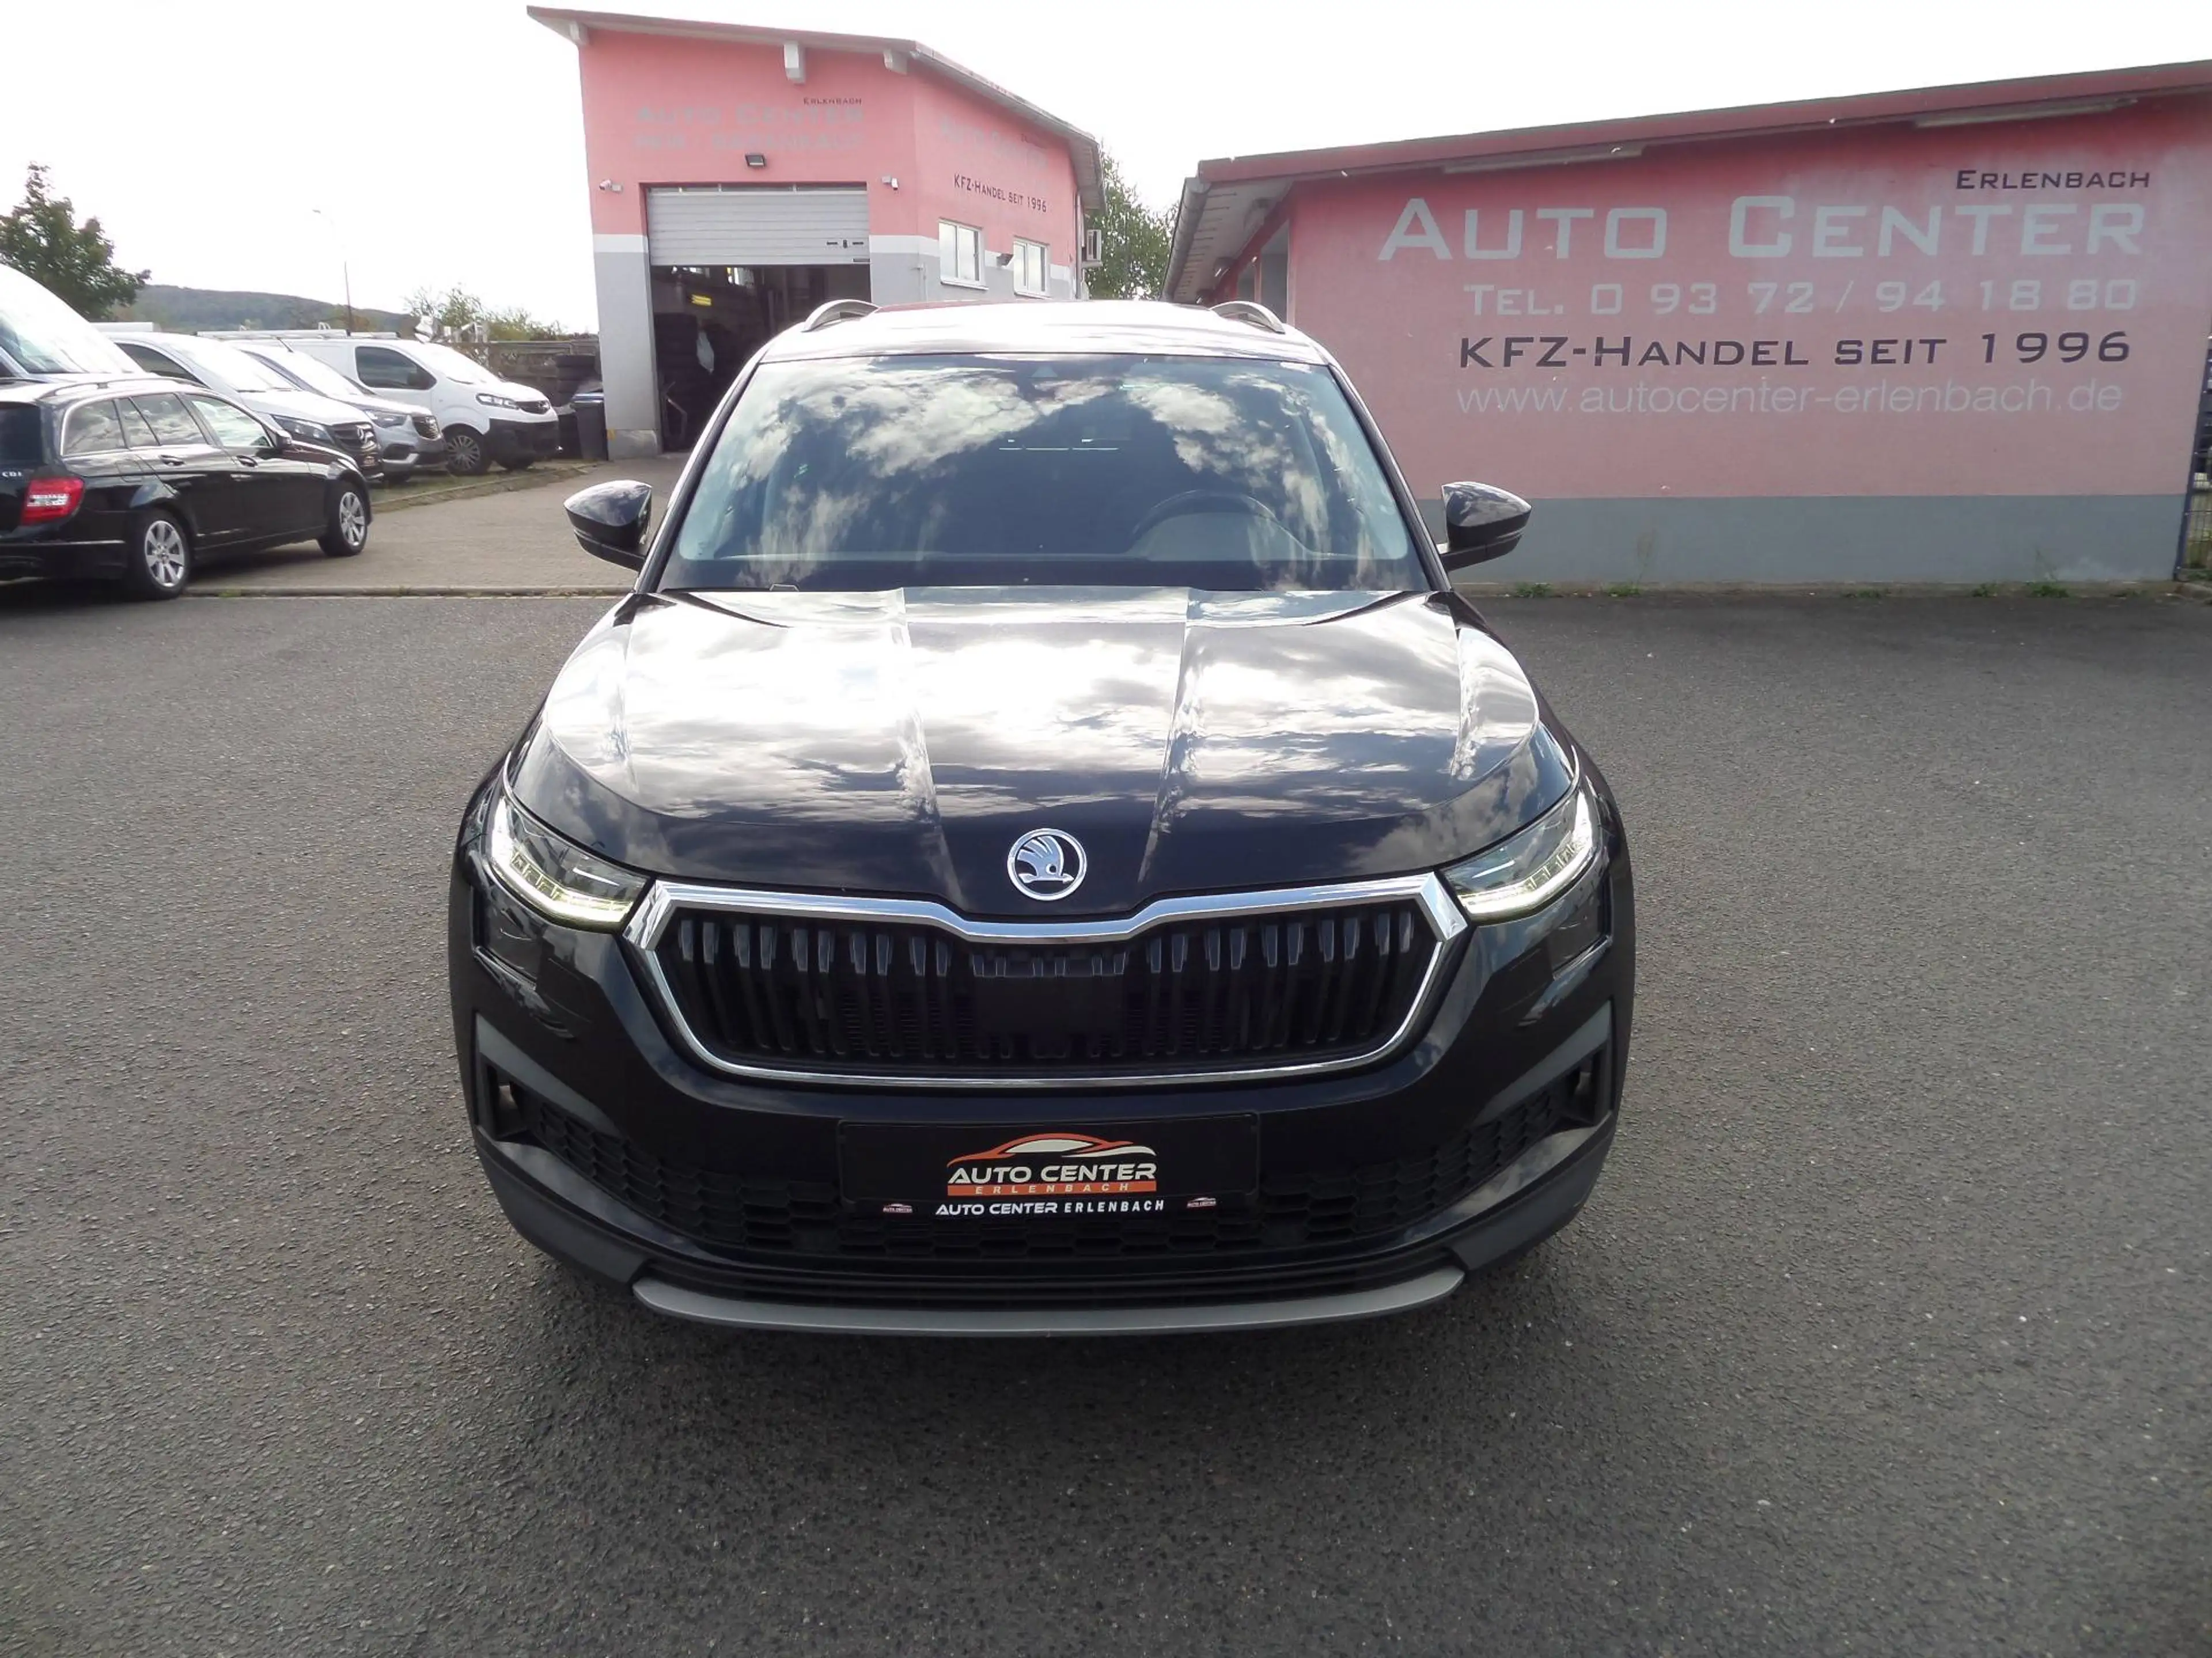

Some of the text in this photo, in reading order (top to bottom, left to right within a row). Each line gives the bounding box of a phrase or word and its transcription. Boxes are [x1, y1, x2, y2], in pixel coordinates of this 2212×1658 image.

[1956, 169, 2150, 189] ERLENBACH
[1007, 191, 1024, 206] SEIT
[1027, 195, 1048, 213] 1996
[1377, 195, 2145, 260] AUTO CENTER
[1463, 284, 1564, 316] TEL.
[1650, 283, 1717, 314] 93
[1747, 281, 1814, 313] 72
[1876, 280, 1946, 312] 94
[1980, 280, 2041, 311] 18
[2067, 279, 2138, 310] 80
[1459, 331, 2130, 369] KFZ-HANDEL SEIT 1996
[1457, 378, 2123, 414] www.autocenter-erlenbach.de
[947, 1163, 1157, 1184] AUTO CENTER
[975, 1183, 1129, 1194] ERLENBACH
[935, 1200, 1165, 1216] AUTO CENTER ERLENBACH
